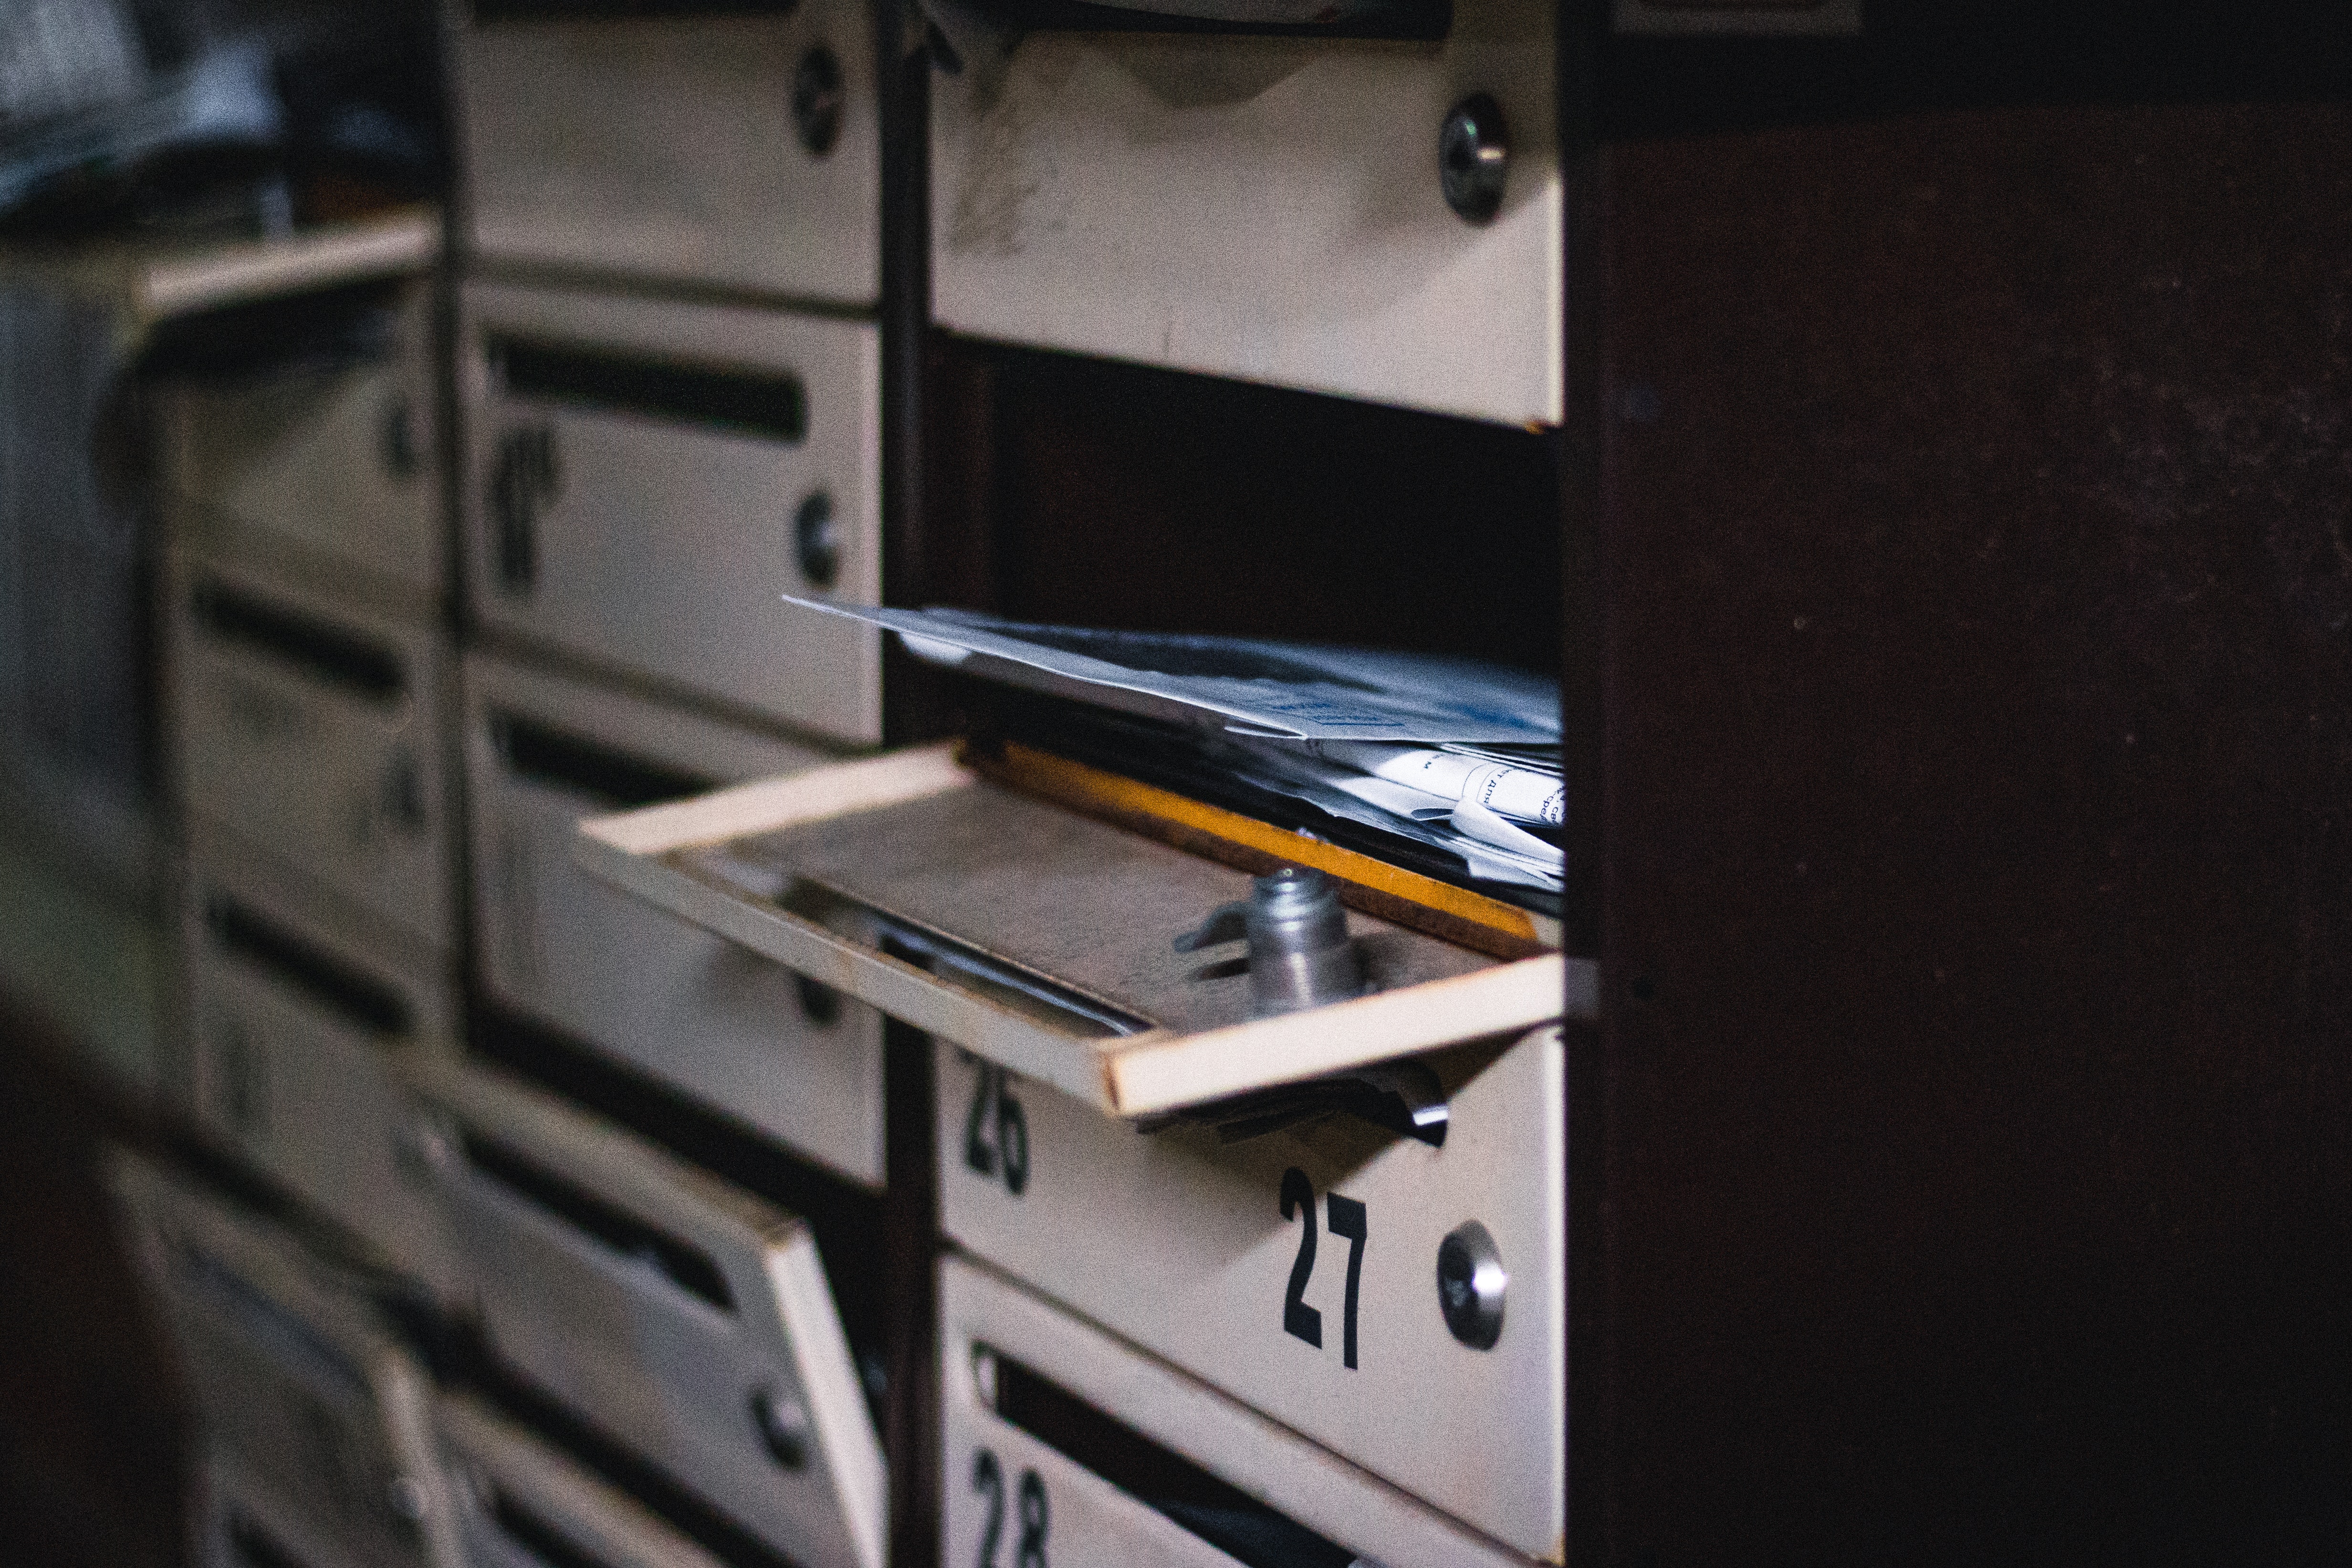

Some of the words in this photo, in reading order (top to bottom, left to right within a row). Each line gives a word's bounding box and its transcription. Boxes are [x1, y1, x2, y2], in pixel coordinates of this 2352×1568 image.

[1484, 780, 1496, 804] для
[1280, 1167, 1367, 1370] 27
[972, 1446, 1050, 1568] 28
